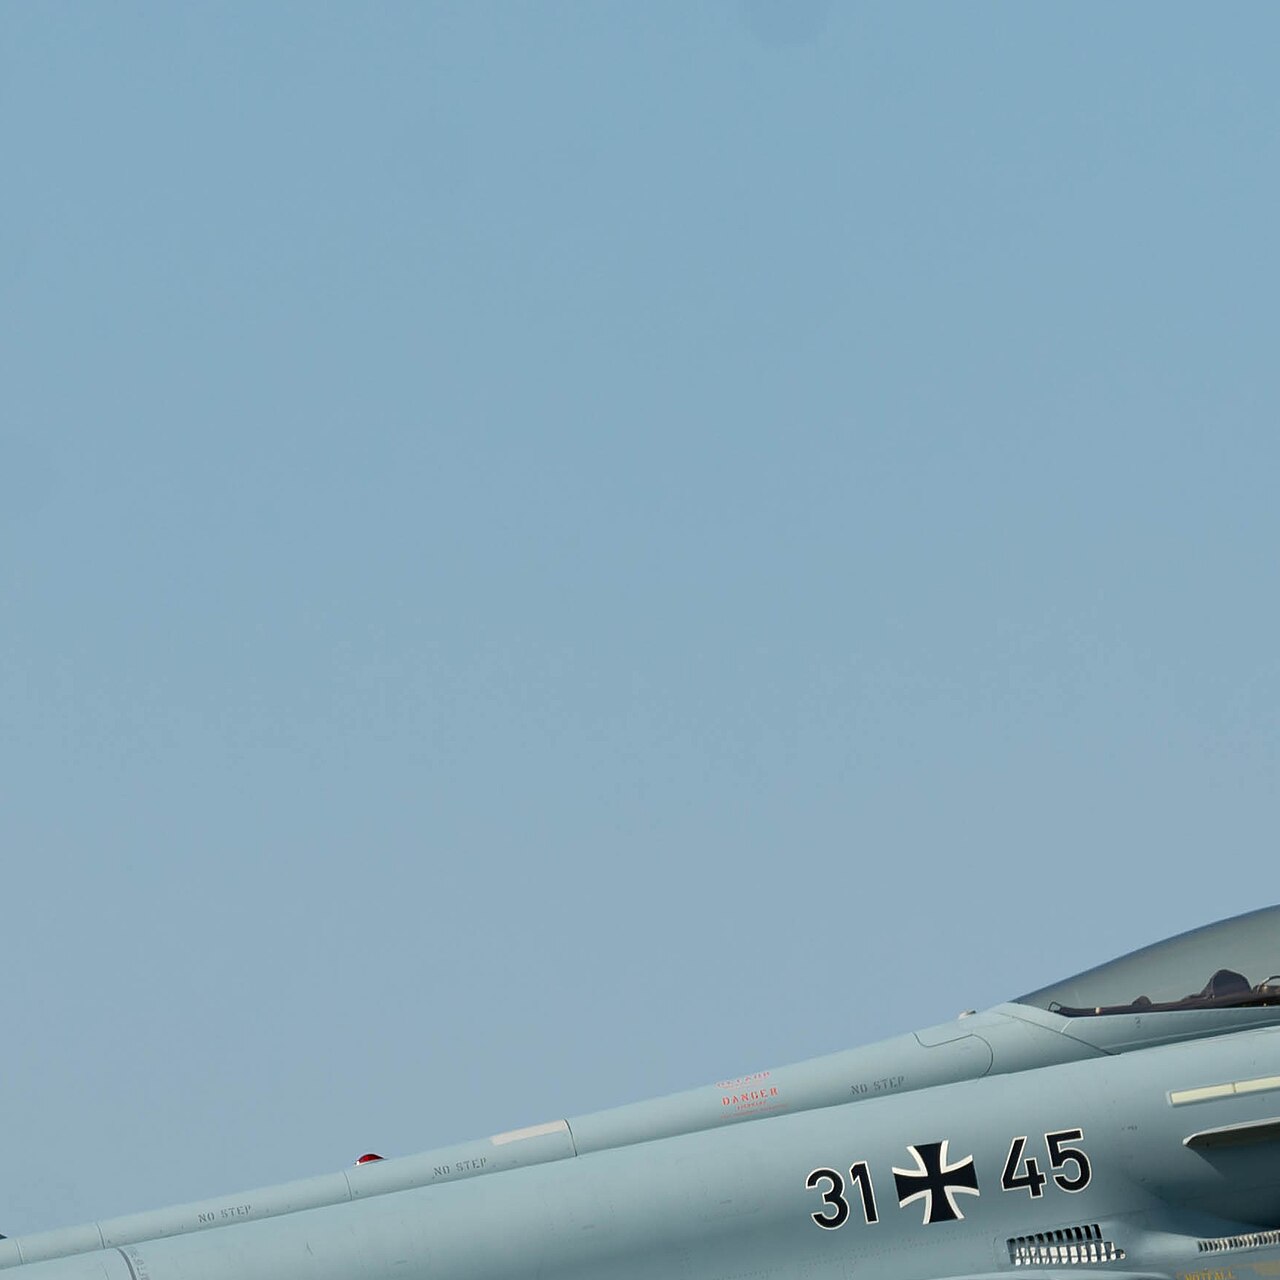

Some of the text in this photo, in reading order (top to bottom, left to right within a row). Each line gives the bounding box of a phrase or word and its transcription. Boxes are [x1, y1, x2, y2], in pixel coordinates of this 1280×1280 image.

[849, 1075, 905, 1095] NO STEP
[721, 1087, 778, 1106] DANGER
[433, 1157, 487, 1176] NO STEP
[805, 1128, 1092, 1231] 31 45
[197, 1204, 251, 1223] NO STEP
